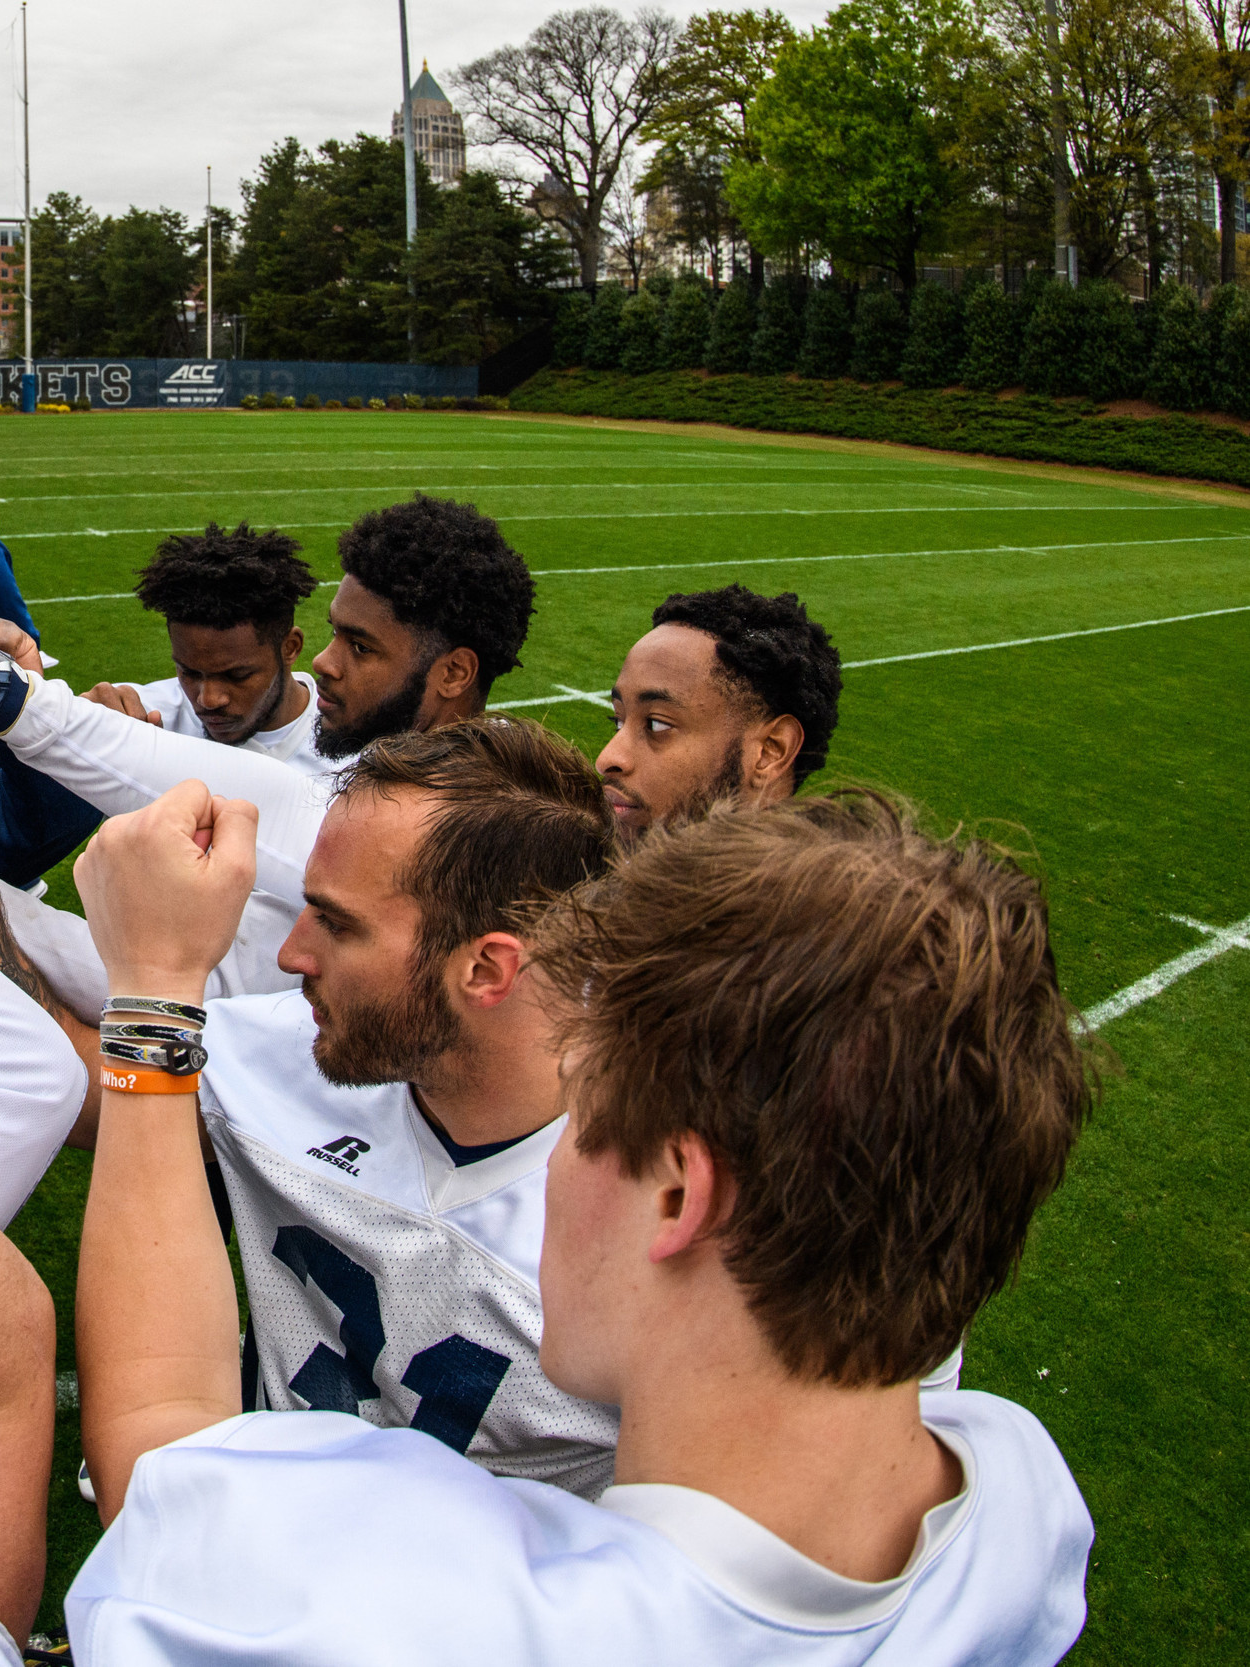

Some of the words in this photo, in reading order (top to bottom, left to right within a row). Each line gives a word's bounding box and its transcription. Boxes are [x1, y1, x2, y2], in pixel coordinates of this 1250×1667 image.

[168, 364, 218, 380] ACC
[102, 1068, 137, 1090] Who?
[306, 1146, 361, 1177] RUSSELL
